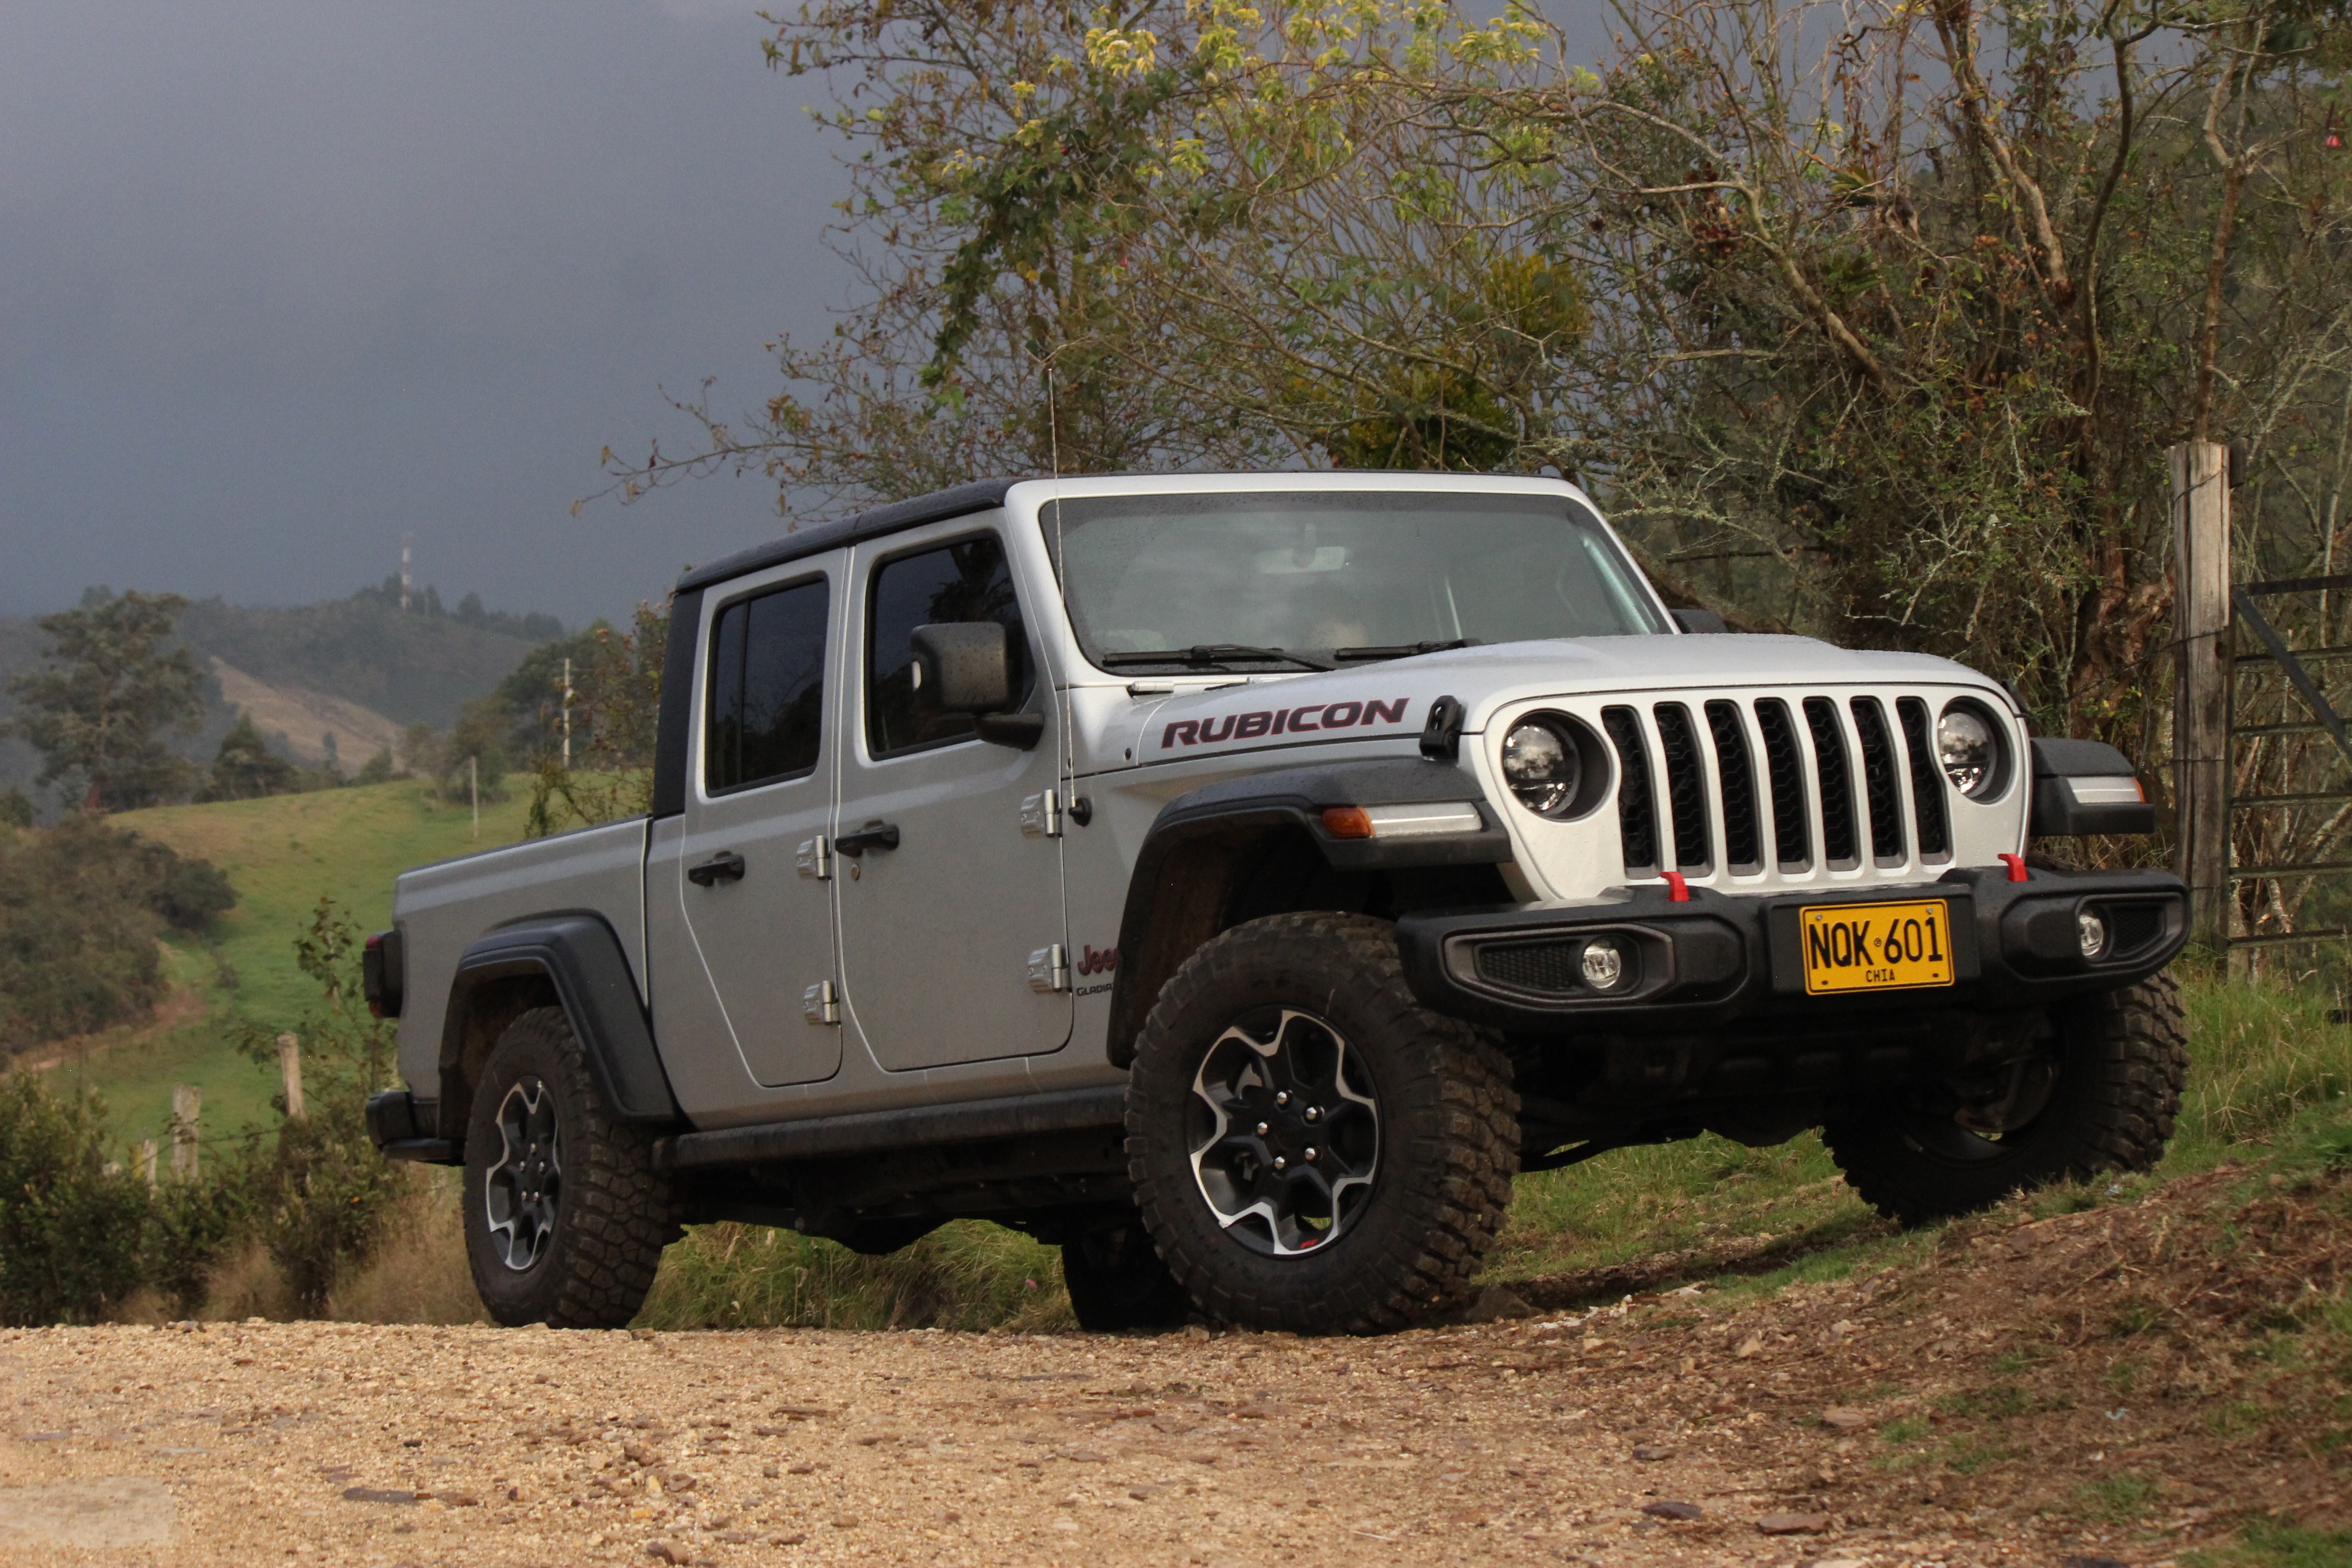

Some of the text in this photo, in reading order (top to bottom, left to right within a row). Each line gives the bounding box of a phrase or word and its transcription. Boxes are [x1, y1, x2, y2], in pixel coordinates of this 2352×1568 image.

[1161, 698, 1411, 748] RUBICON
[1809, 917, 1943, 969] NQK 601
[1078, 945, 1118, 975] Jee
[1077, 983, 1114, 996] GLADIA
[1866, 969, 1896, 982] CHIA
